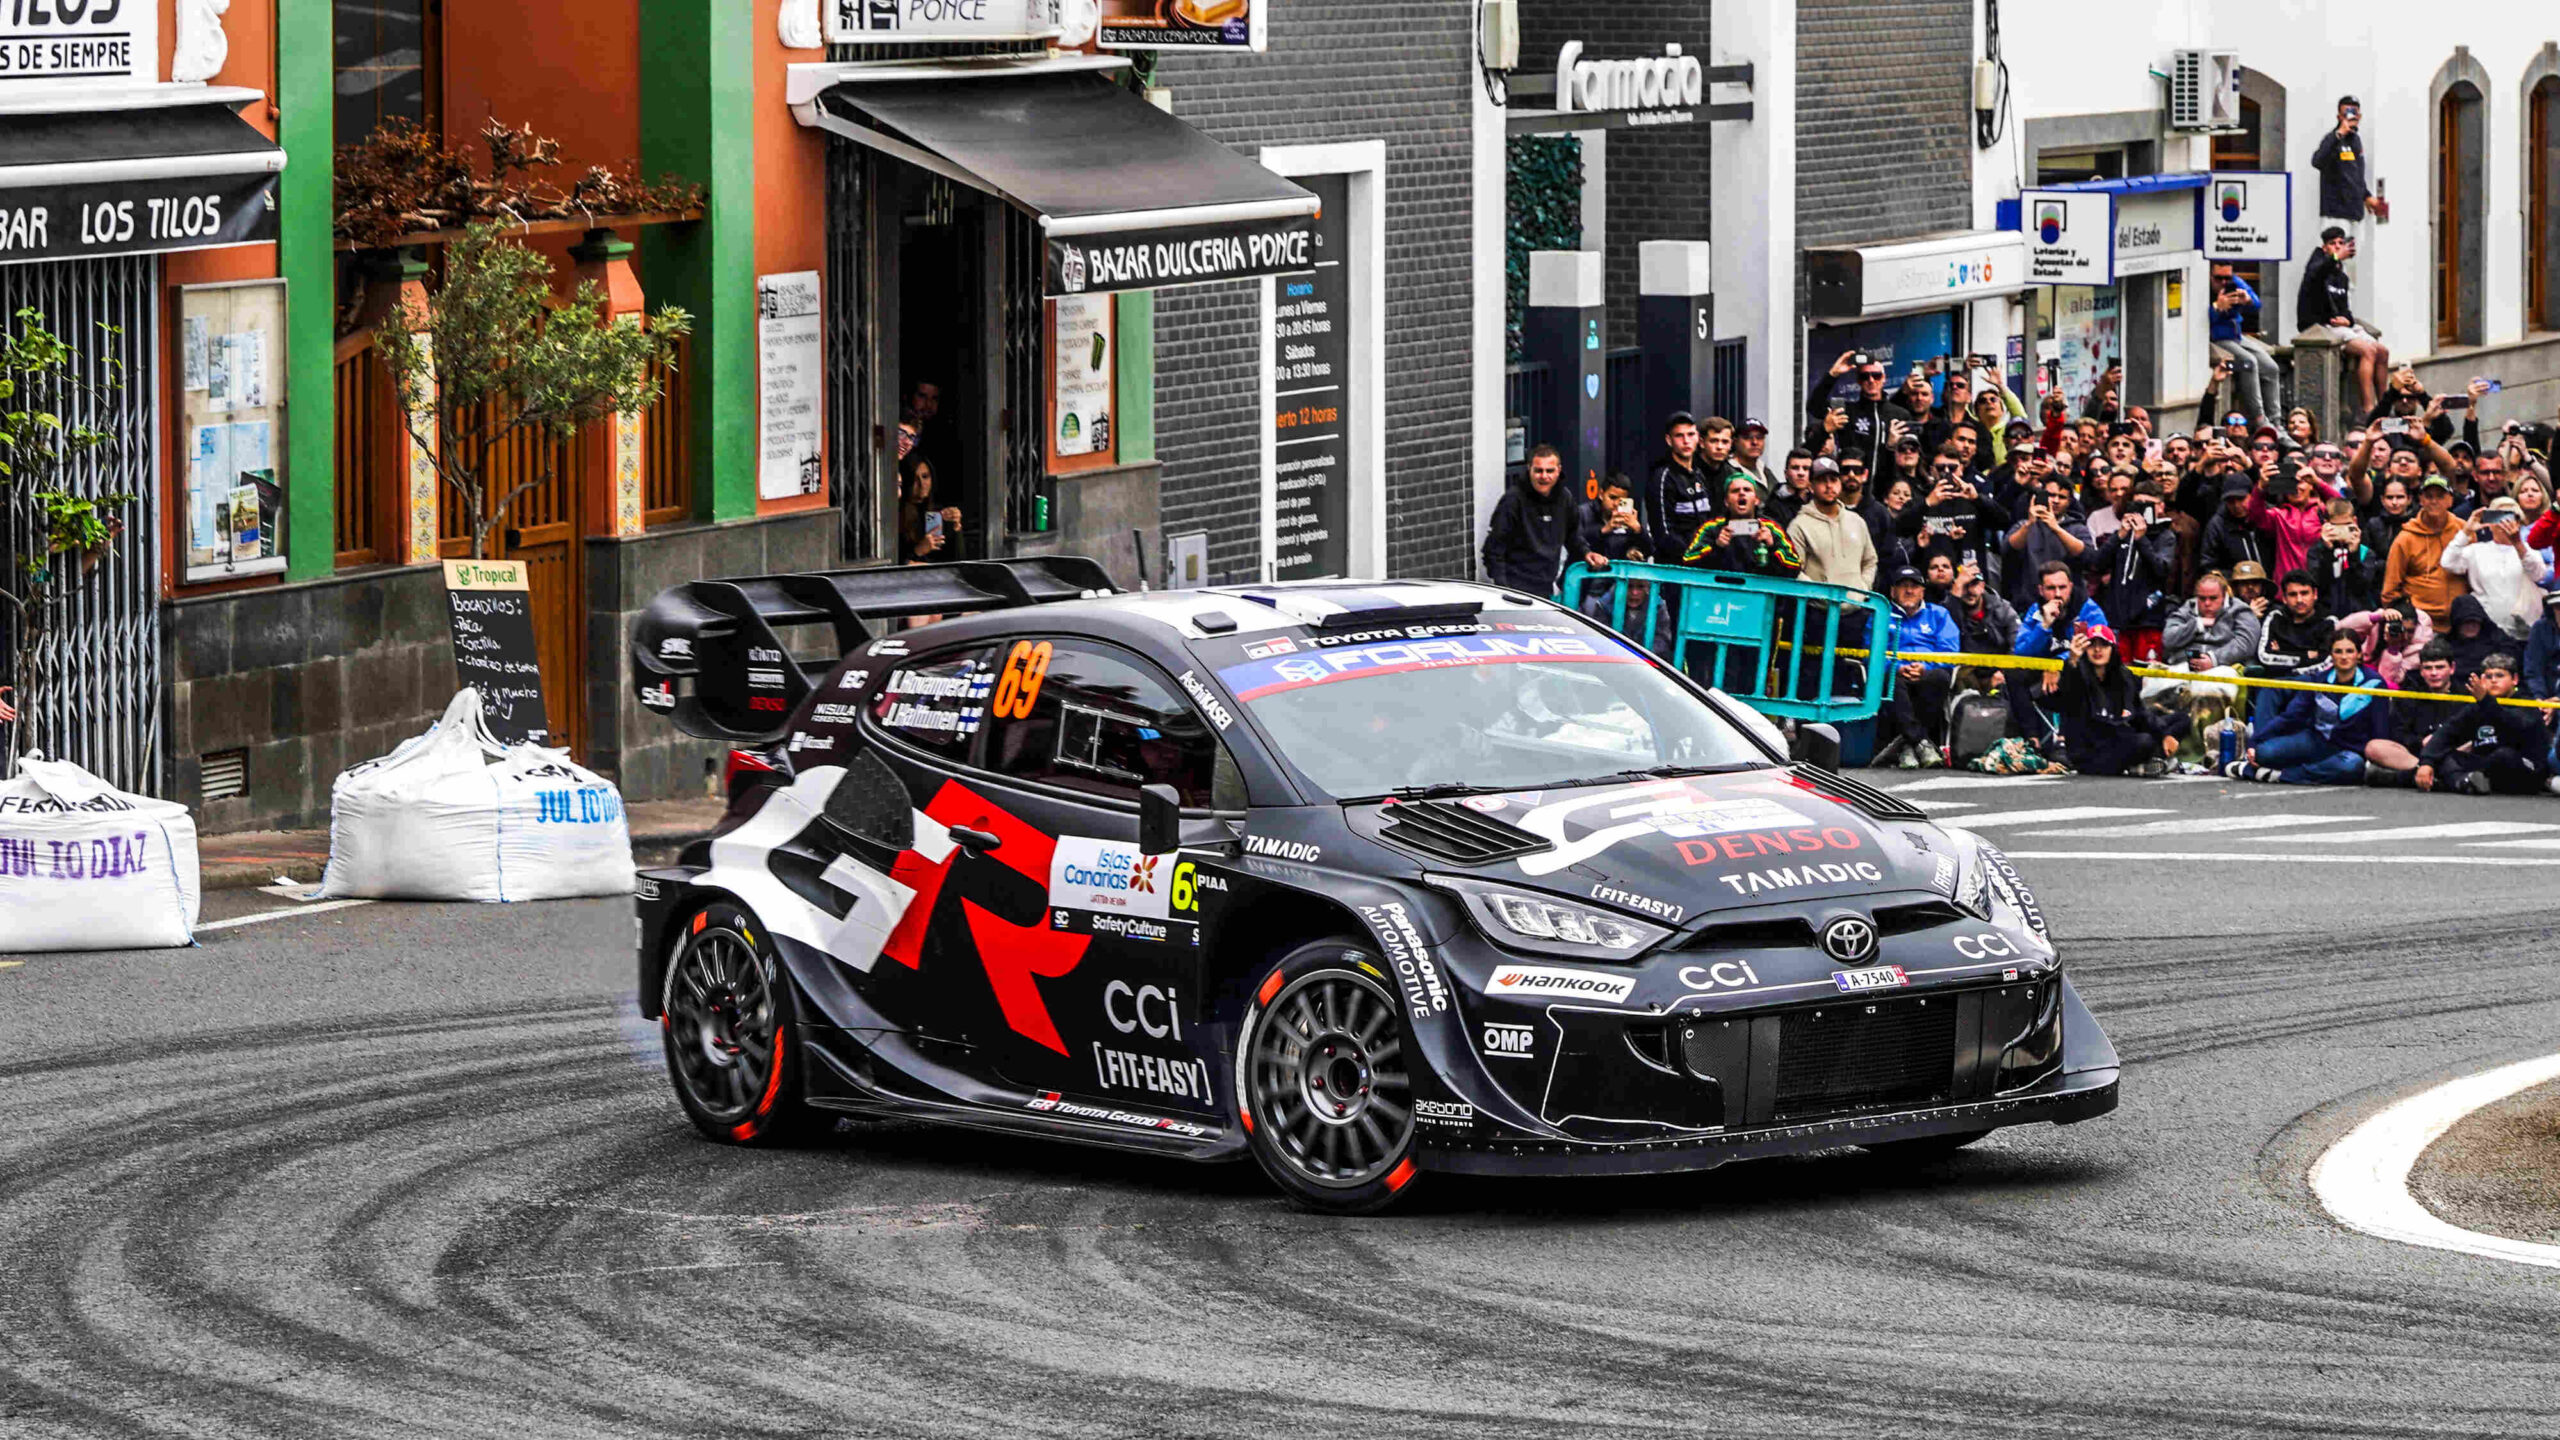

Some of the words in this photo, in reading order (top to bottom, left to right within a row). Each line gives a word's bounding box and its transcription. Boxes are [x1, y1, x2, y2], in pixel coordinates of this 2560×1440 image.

[18, 44, 43, 70] DE
[50, 41, 131, 68] SIEMPRE
[82, 200, 135, 244] LOS
[147, 195, 221, 239] TILOS
[2119, 227, 2131, 249] del
[2133, 221, 2161, 246] Estado
[2215, 234, 2254, 244] Apuestas
[2256, 234, 2268, 243] del
[1090, 245, 1153, 284] BAZAR
[1155, 236, 1247, 278] DULCERIA
[1249, 230, 1309, 268] PONCE
[2215, 244, 2243, 253] Estado
[2033, 267, 2063, 276] Estado
[2034, 257, 2074, 267] Apuestas
[2076, 258, 2089, 267] del
[1300, 300, 1327, 316] Viernes
[1312, 318, 1331, 333] horas
[1697, 308, 1708, 340] 5
[1285, 343, 1316, 360] Sábados
[1311, 361, 1331, 377] horas
[1299, 407, 1310, 425] 12
[1311, 406, 1338, 423] horas
[472, 565, 517, 587] Tropical
[1299, 628, 1402, 649] TOYOTA
[1406, 622, 1493, 640] GAZOO
[1496, 622, 1576, 635] Racing
[1320, 637, 1598, 673] FORUM8
[993, 639, 1054, 719] 69
[91, 831, 147, 878] DIAZ
[1246, 835, 1320, 862] TAMADIC
[1673, 827, 1861, 866] DENSO
[1097, 848, 1132, 870] Islas
[1064, 864, 1128, 890] Canarias
[1197, 874, 1228, 892] PIAA
[1719, 861, 1882, 895] TAMADIC
[1054, 910, 1070, 925] SC
[1092, 914, 1167, 938] SafetyCulture
[1358, 905, 1430, 1019] AUTOMOTIVE
[1380, 902, 1448, 1012] Panasonic
[1851, 970, 1895, 987] A-7540
[1484, 1028, 1534, 1052] OMP
[1054, 1102, 1109, 1119] TOYOTA
[1108, 1111, 1159, 1127] GAZOO
[1157, 1117, 1205, 1136] Racing
[1415, 1099, 1472, 1116] akebono
